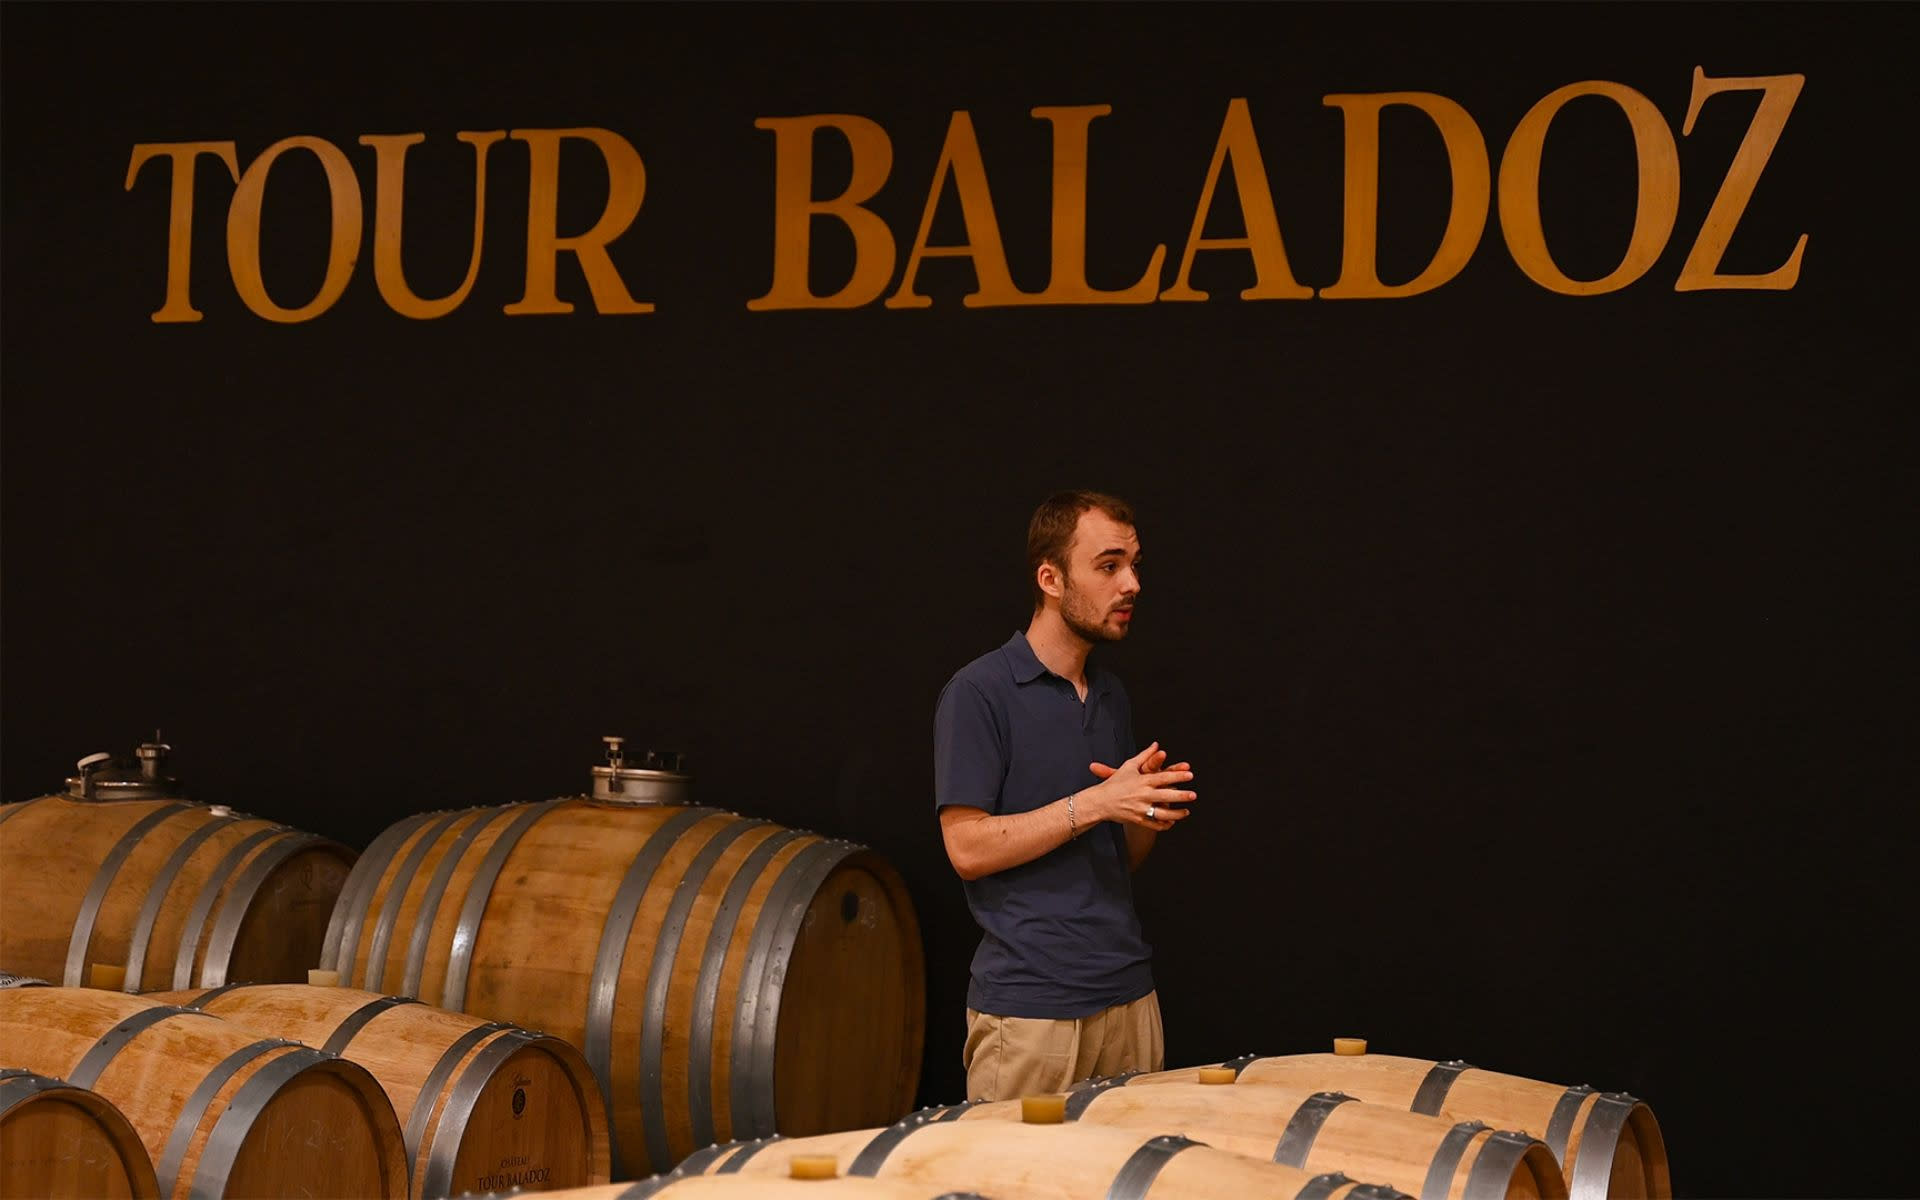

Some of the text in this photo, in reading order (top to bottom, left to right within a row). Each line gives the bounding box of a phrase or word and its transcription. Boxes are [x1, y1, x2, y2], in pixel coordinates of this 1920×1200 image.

[125, 65, 1809, 324] TOUR BALADOZ
[477, 1167, 551, 1192] TOUR BALADOZ
